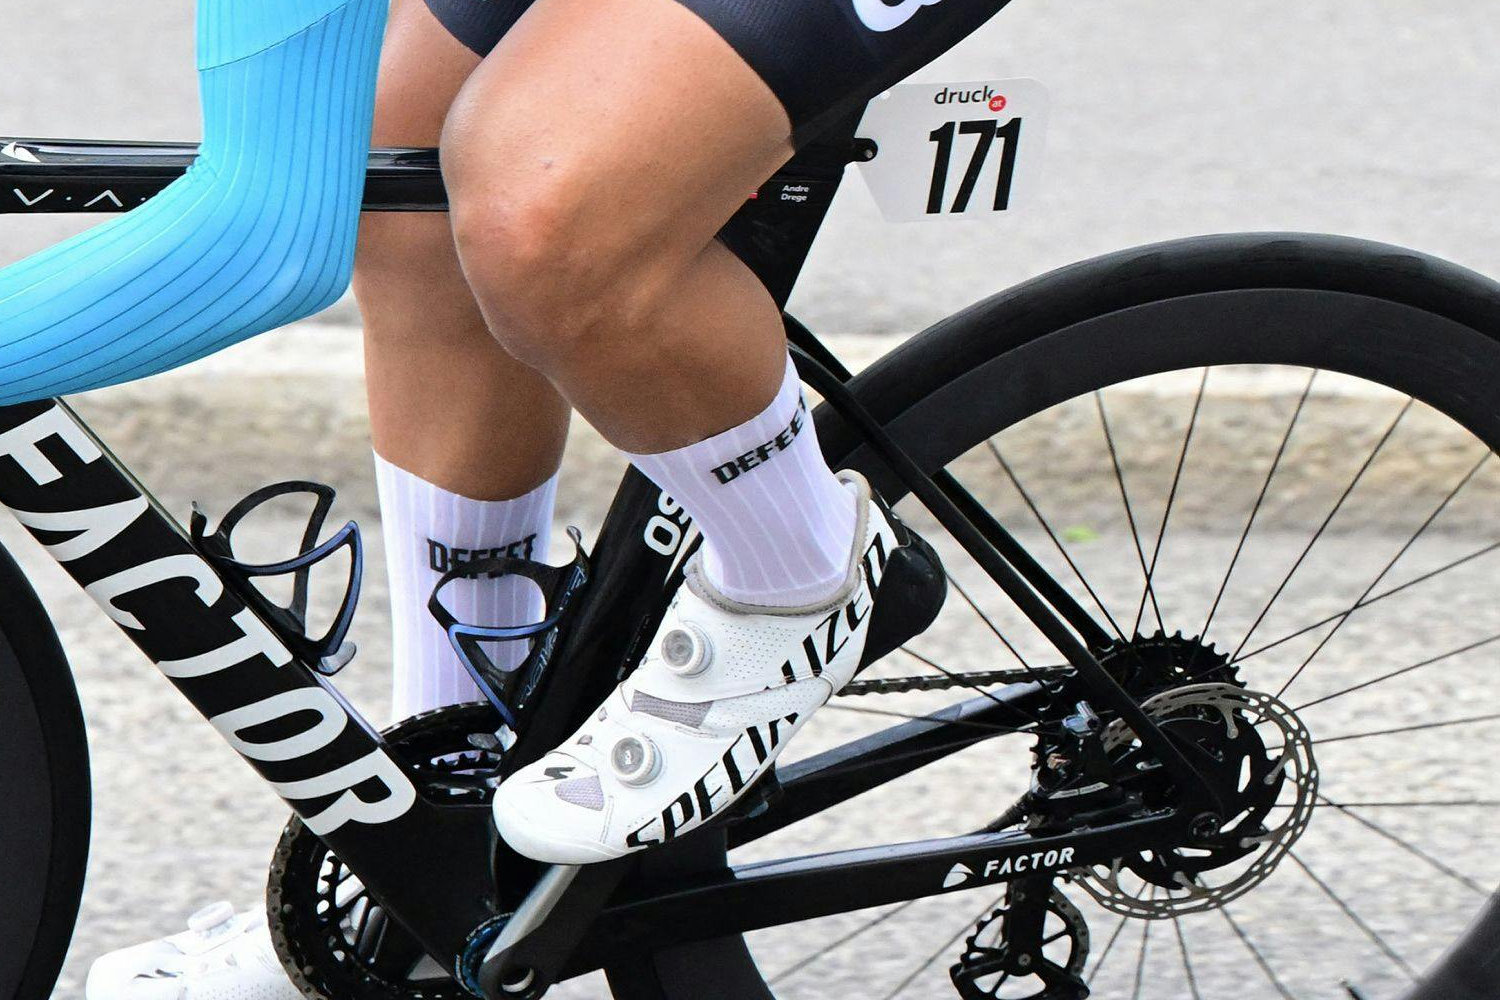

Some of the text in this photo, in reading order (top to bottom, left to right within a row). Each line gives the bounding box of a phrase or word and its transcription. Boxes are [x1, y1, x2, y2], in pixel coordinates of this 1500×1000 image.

[933, 85, 995, 105] druck
[926, 117, 1022, 214] 171
[644, 489, 692, 556] OS
[983, 846, 1075, 878] FACTOR
